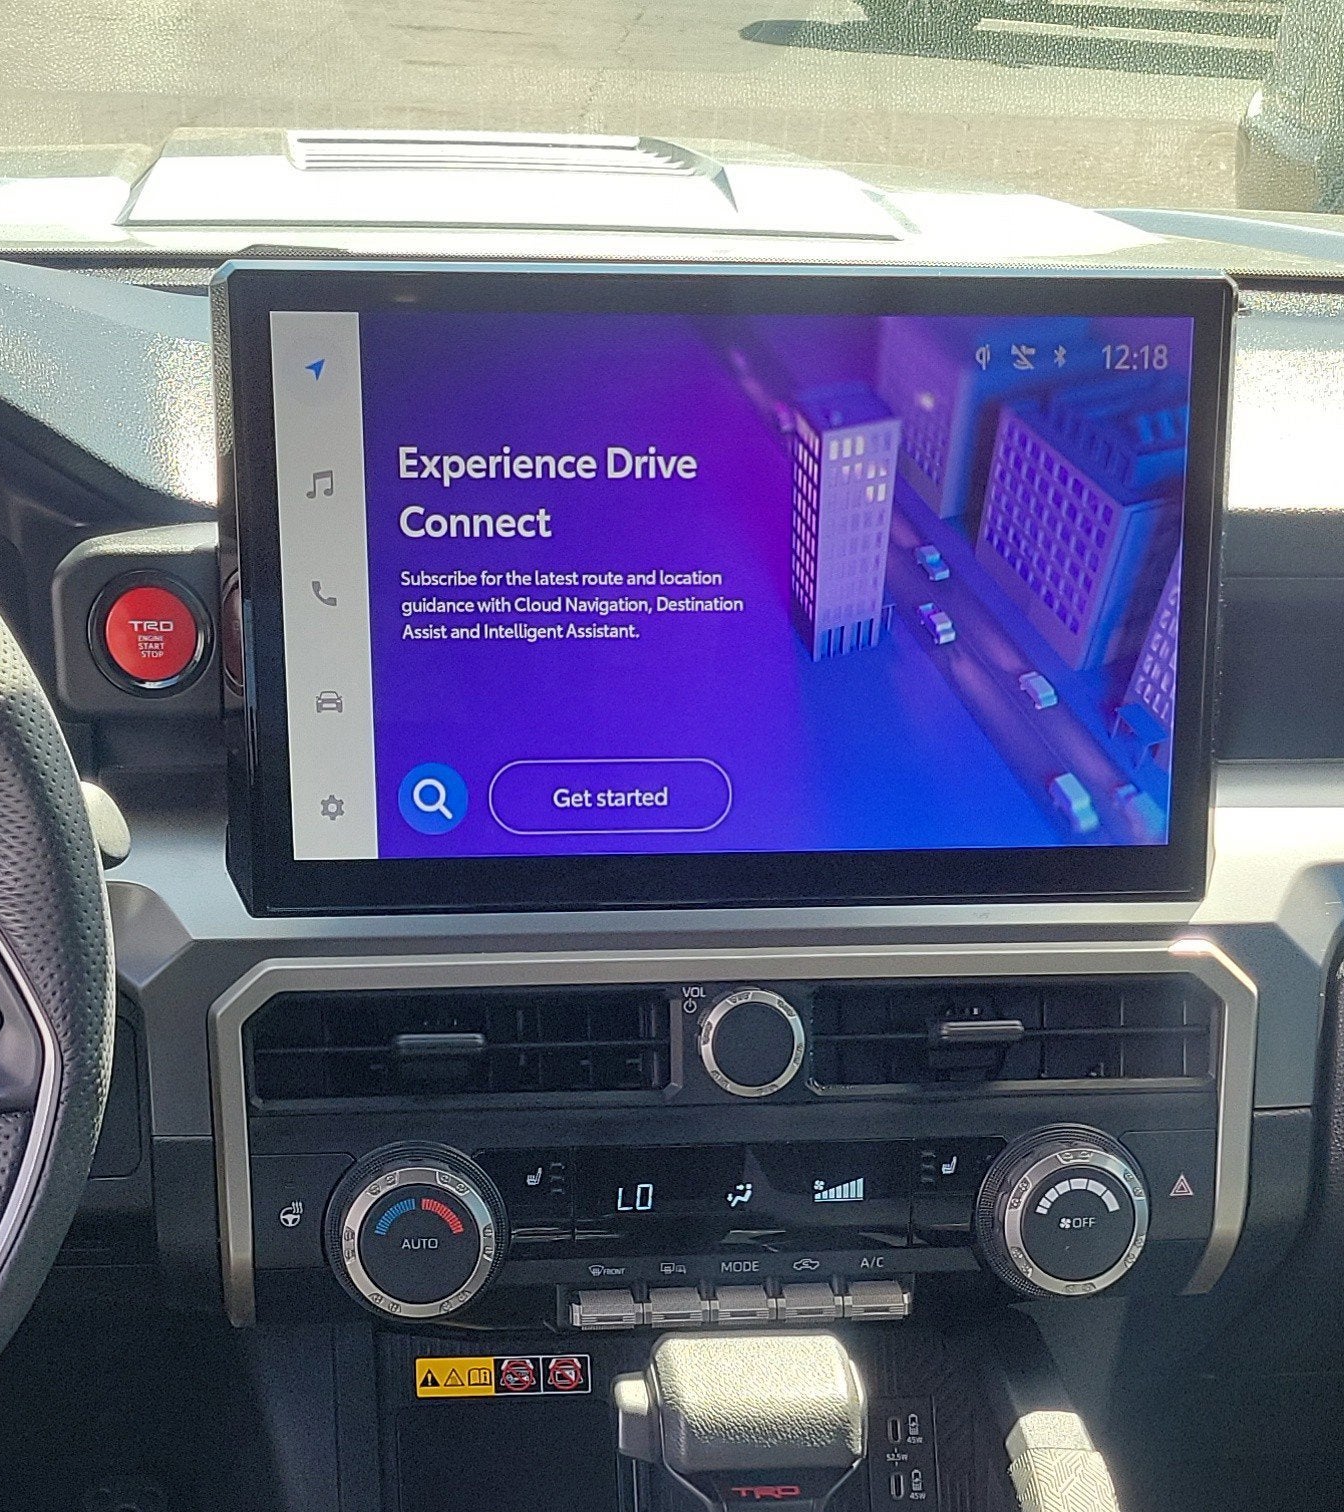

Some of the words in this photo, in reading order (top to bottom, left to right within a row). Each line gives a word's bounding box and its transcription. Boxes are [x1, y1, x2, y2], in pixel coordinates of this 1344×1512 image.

[1101, 342, 1168, 372] 12:18
[397, 445, 598, 488] Experience
[606, 446, 699, 480] Drive
[399, 504, 553, 539] Connect
[400, 569, 478, 587] Subscribe
[480, 569, 503, 586] for
[505, 569, 532, 586] the
[534, 569, 580, 586] latest
[582, 571, 624, 586] route
[626, 569, 657, 586] and
[659, 569, 723, 586] location
[401, 596, 475, 617] guidance
[477, 596, 512, 613] with
[514, 596, 562, 613] Cloud
[565, 596, 653, 616] Navigation,
[656, 595, 744, 613] Destination
[127, 620, 174, 632] TRD
[402, 623, 448, 640] Assist
[450, 622, 481, 640] and
[484, 622, 564, 643] Intelligent
[566, 623, 640, 639] Assistant.
[138, 642, 165, 651] START
[141, 650, 164, 658] STOP
[552, 784, 590, 808] Get
[597, 783, 670, 808] started
[682, 986, 707, 998] VOL
[617, 1183, 654, 1211] LO
[1072, 1217, 1096, 1229] OFF
[401, 1237, 438, 1250] AUTO
[720, 1261, 760, 1273] MODE
[860, 1256, 885, 1269] A/C
[603, 1267, 626, 1276] FRONT
[906, 1436, 923, 1444] 45W
[730, 1485, 801, 1499] TRD
[909, 1492, 927, 1501] 45W
